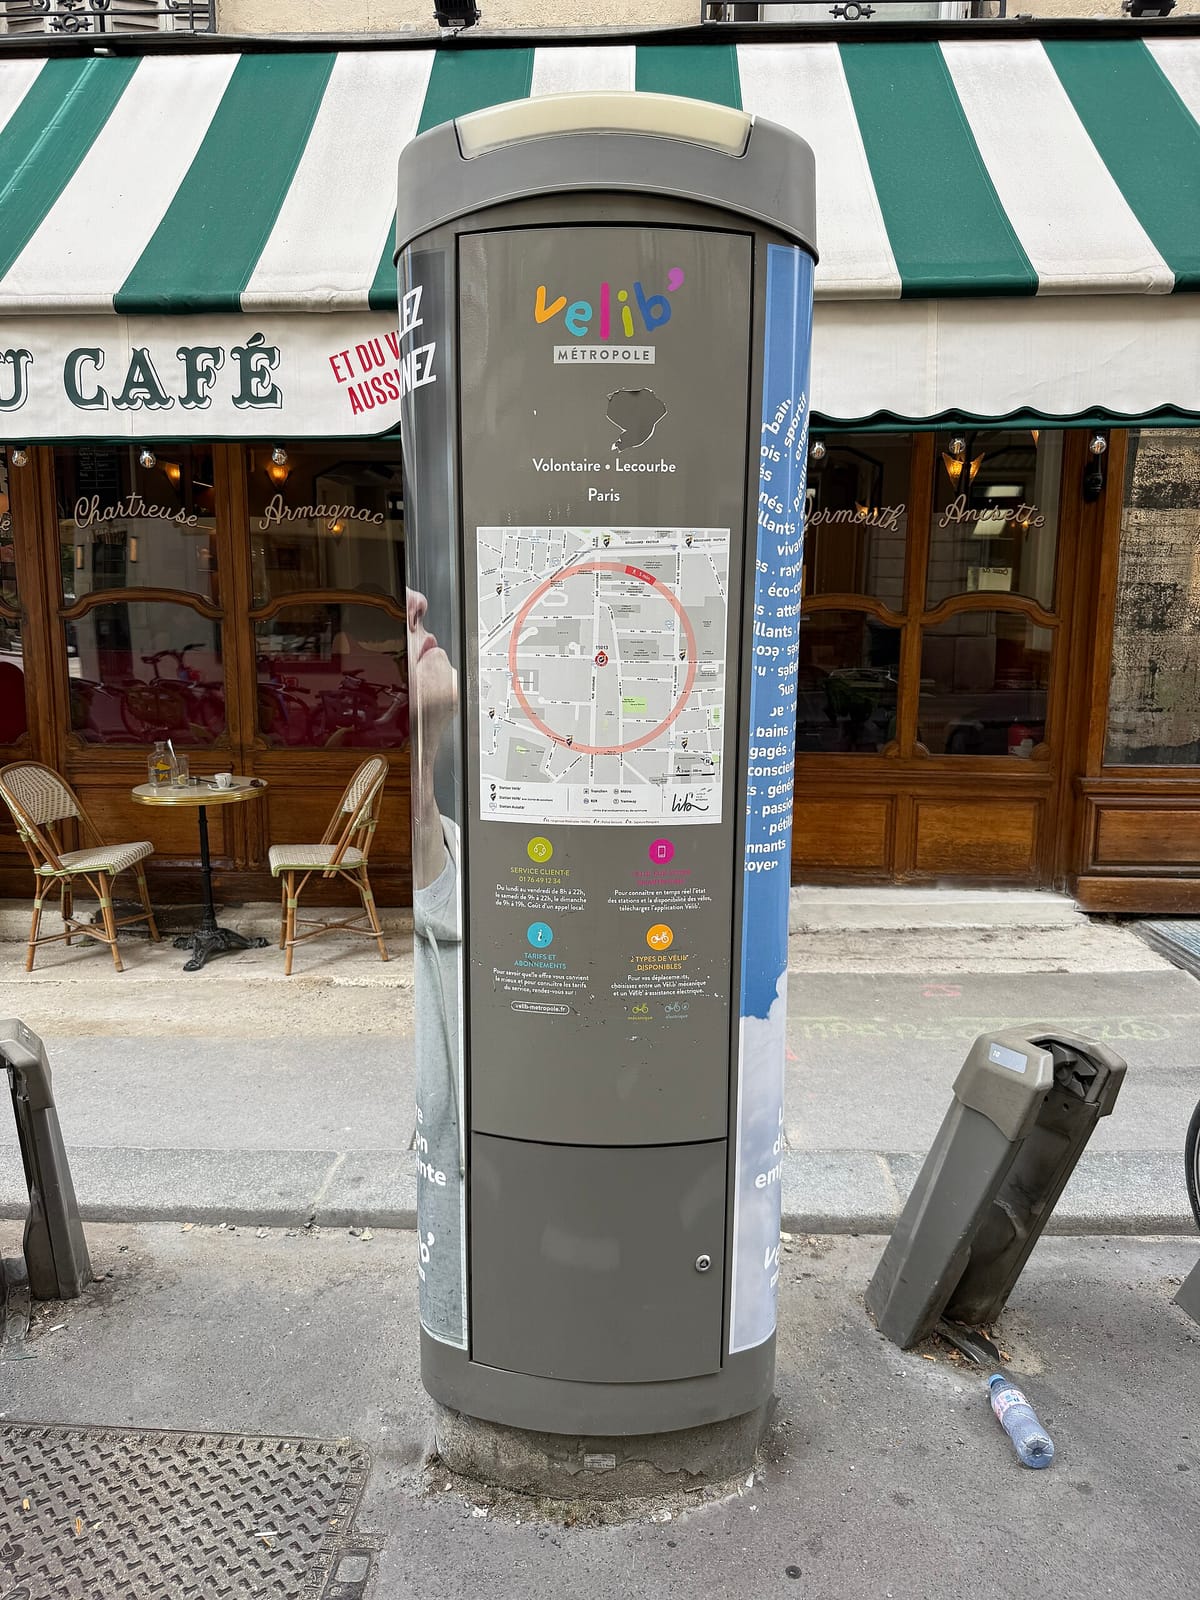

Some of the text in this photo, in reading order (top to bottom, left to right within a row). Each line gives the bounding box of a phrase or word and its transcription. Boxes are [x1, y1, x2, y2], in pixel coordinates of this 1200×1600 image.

[400, 285, 424, 339] EZ
[329, 350, 355, 384] ET
[355, 338, 386, 373] DU
[558, 347, 650, 360] MÉTROPOLE
[63, 332, 283, 411] CAFÉ
[532, 458, 676, 472] Volontaire Lecourbe
[74, 492, 384, 531] Chartreuse Armagnac
[588, 488, 620, 502] Paris
[938, 494, 1045, 528] Anisette
[514, 960, 566, 969] ABONNEMENTS
